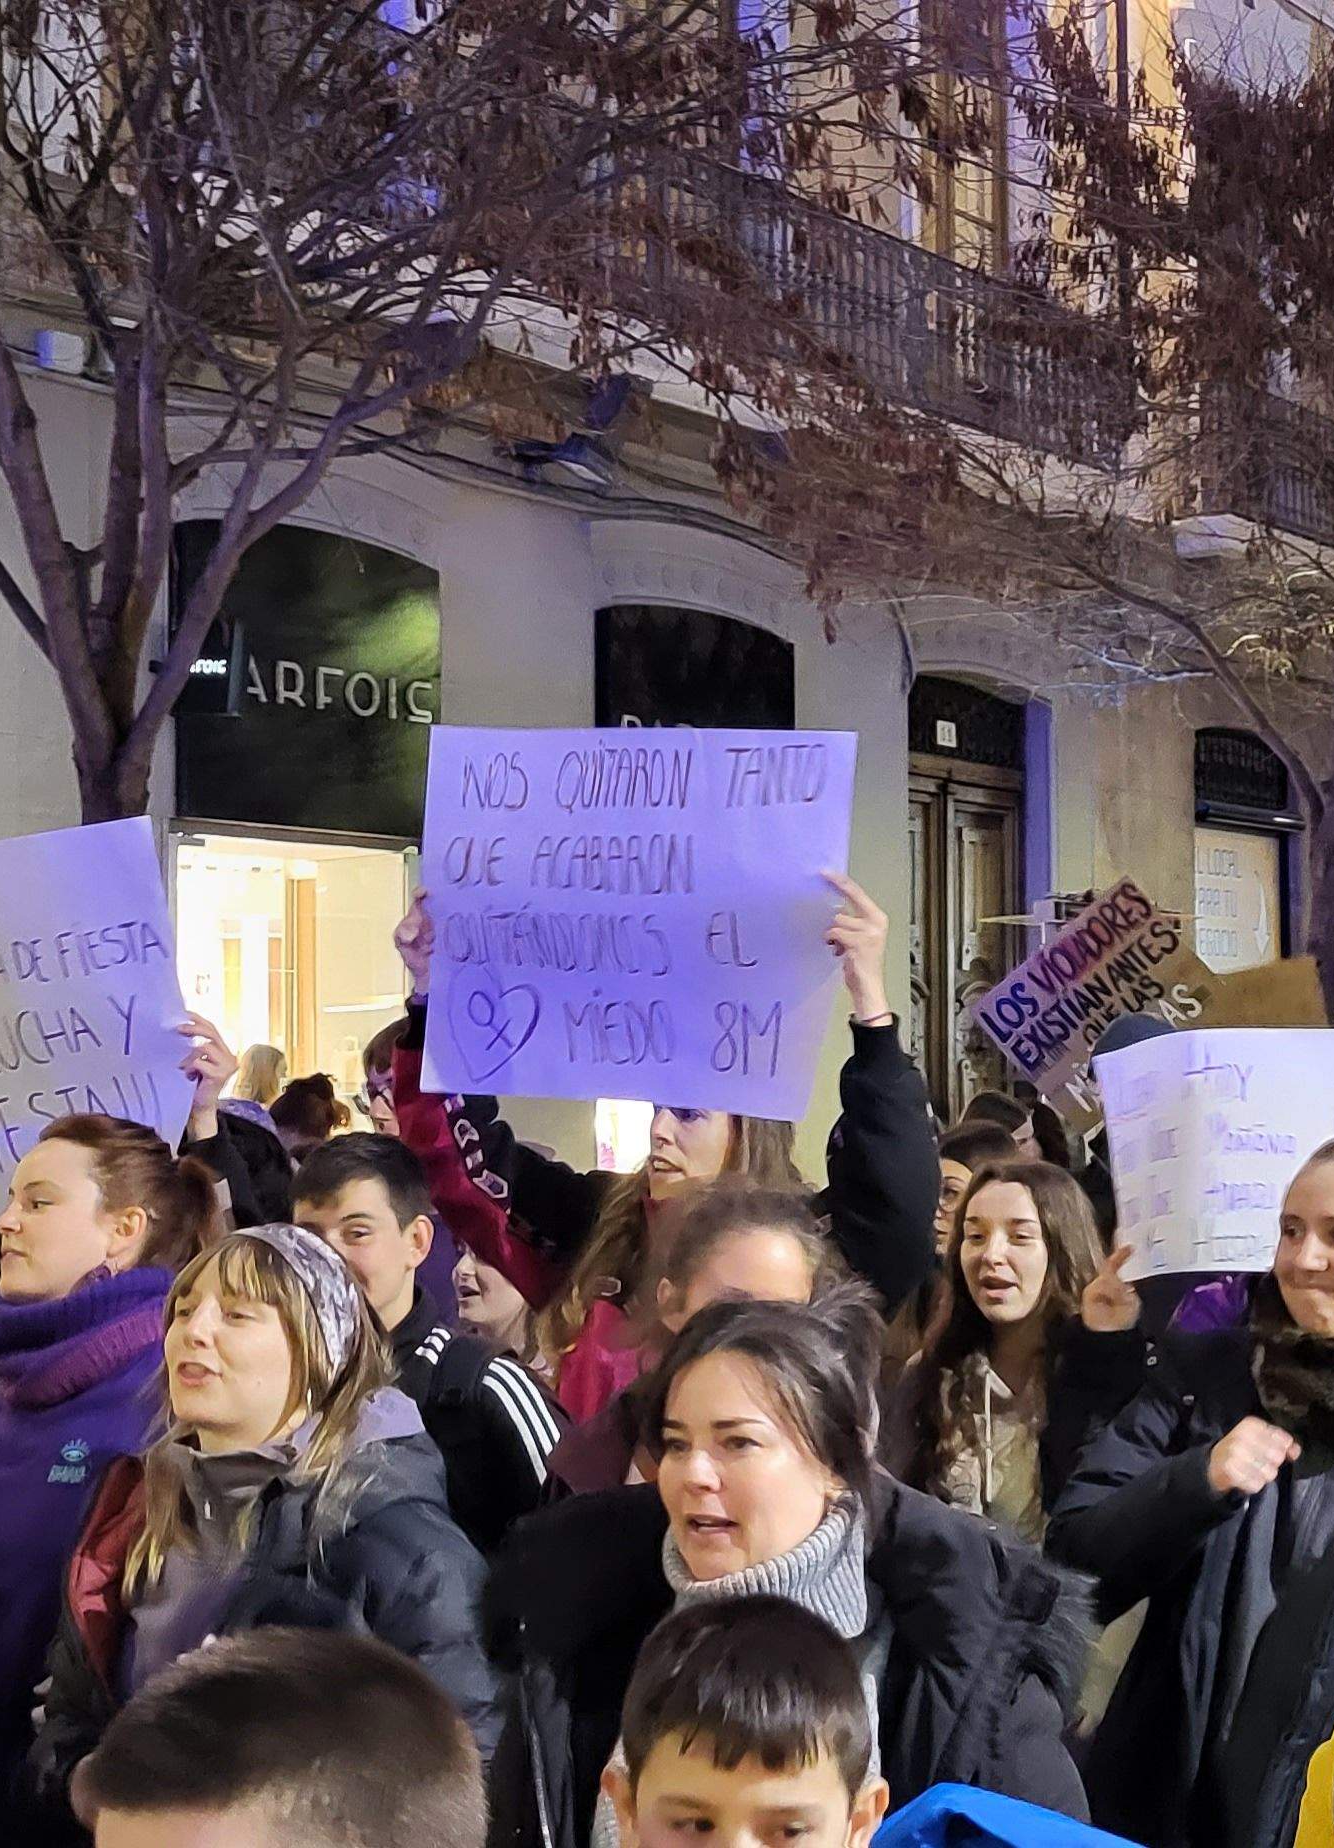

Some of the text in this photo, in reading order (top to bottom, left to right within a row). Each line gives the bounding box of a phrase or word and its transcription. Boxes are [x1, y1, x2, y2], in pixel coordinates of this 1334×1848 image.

[247, 652, 433, 724] ARFOIS
[461, 739, 828, 814] NOS QUITARON TANTO
[443, 832, 696, 895] QUE ACABARON
[10, 938, 51, 983] DE
[54, 920, 170, 978] FIESTA
[705, 910, 759, 969] EL
[980, 882, 1153, 1044] LOS VIOLADORES
[107, 993, 137, 1056] Y
[1010, 972, 1114, 1074] EXISTIAN
[1105, 921, 1180, 992] ANTES
[1119, 975, 1166, 1013] LAS
[562, 986, 783, 1079] MIEDO 8M
